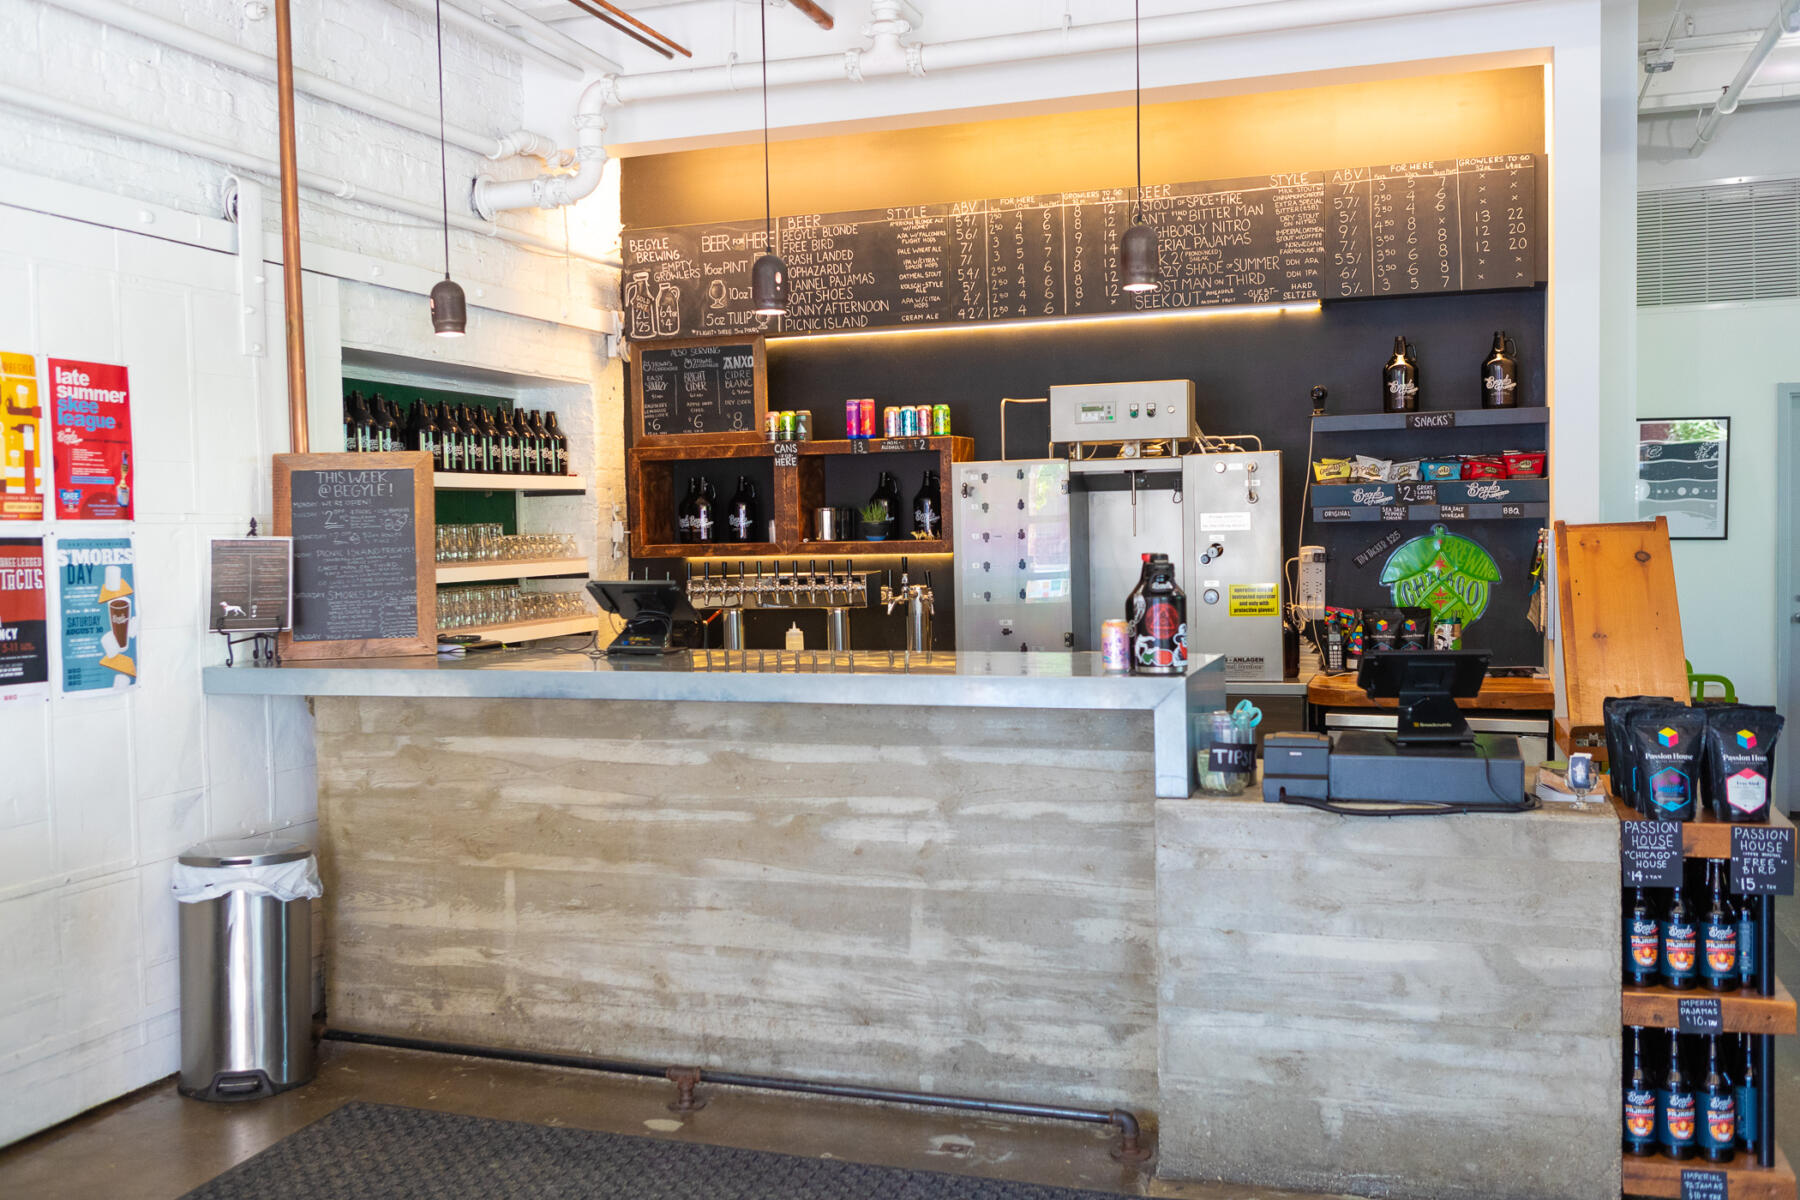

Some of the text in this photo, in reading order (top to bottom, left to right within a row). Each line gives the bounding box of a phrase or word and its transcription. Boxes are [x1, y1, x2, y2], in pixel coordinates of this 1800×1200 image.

[1410, 162, 1434, 170] HERE
[1459, 156, 1503, 167] GROWLERS
[1270, 172, 1309, 188] STYLE
[1332, 168, 1363, 183] ABV
[1063, 191, 1099, 200] GROWLERS
[1136, 185, 1171, 199] BEER
[953, 201, 977, 215] ABV
[1140, 193, 1243, 213] STOUT SPICE FIRE
[886, 206, 926, 220] STYLE
[1188, 208, 1231, 223] BITTER
[1235, 204, 1264, 217] MAN
[1275, 206, 1299, 215] BITTER
[1507, 207, 1524, 220] 22
[788, 214, 821, 229] BEER
[1154, 219, 1251, 238] GHBORLY NITRO
[783, 224, 858, 242] BEGYLE BLONDE
[1475, 222, 1526, 236] 12 20
[630, 237, 669, 253] BEGYLE
[701, 231, 775, 253] BEER FOR HERE
[782, 239, 834, 254] FREE BIRD
[1194, 232, 1252, 249] PAJAMAS
[1476, 237, 1527, 252] 12 20
[636, 250, 680, 263] BREWING
[817, 250, 853, 263] LANDED
[662, 259, 693, 273] EMPTY
[723, 260, 748, 274] PINT
[1185, 256, 1280, 276] SHADE SUMMER
[654, 268, 701, 282] GROWLERS
[1181, 277, 1213, 291] MAN
[1225, 272, 1265, 287] THIRD
[788, 272, 875, 293] LANNEL PAJAMAS
[1291, 282, 1312, 290] HARD
[815, 287, 854, 302] SHOES
[1135, 292, 1201, 310] SEEK OUT
[1283, 290, 1317, 300] SELTZER
[784, 300, 890, 318] SUNNY AFTERNOON
[785, 315, 868, 331] PICNIC ISLAND
[690, 347, 720, 356] SERVING
[55, 366, 90, 386] late
[725, 370, 750, 380] CIDRE
[725, 380, 753, 389] BLANC
[56, 385, 127, 404] summer
[57, 395, 99, 414] skee
[58, 407, 115, 431] league
[1414, 415, 1448, 428] SNACKS
[774, 443, 798, 453] CANS
[775, 457, 797, 467] HERE
[315, 471, 388, 485] THIS WEEK
[1503, 507, 1520, 515] BBQ
[57, 548, 135, 566] S'MORES
[67, 563, 94, 585] DAY
[67, 615, 101, 628] SATURDAY
[1723, 754, 1750, 762] Passion
[1624, 822, 1678, 833] PASSION
[1734, 827, 1789, 841] PASSION
[1632, 834, 1673, 847] HOUSE
[1740, 841, 1782, 853] HOUSE
[1636, 861, 1667, 869] HOUSE
[1683, 1172, 1721, 1181] IMPERIAL
[1685, 1182, 1723, 1190] PAJAMAS
